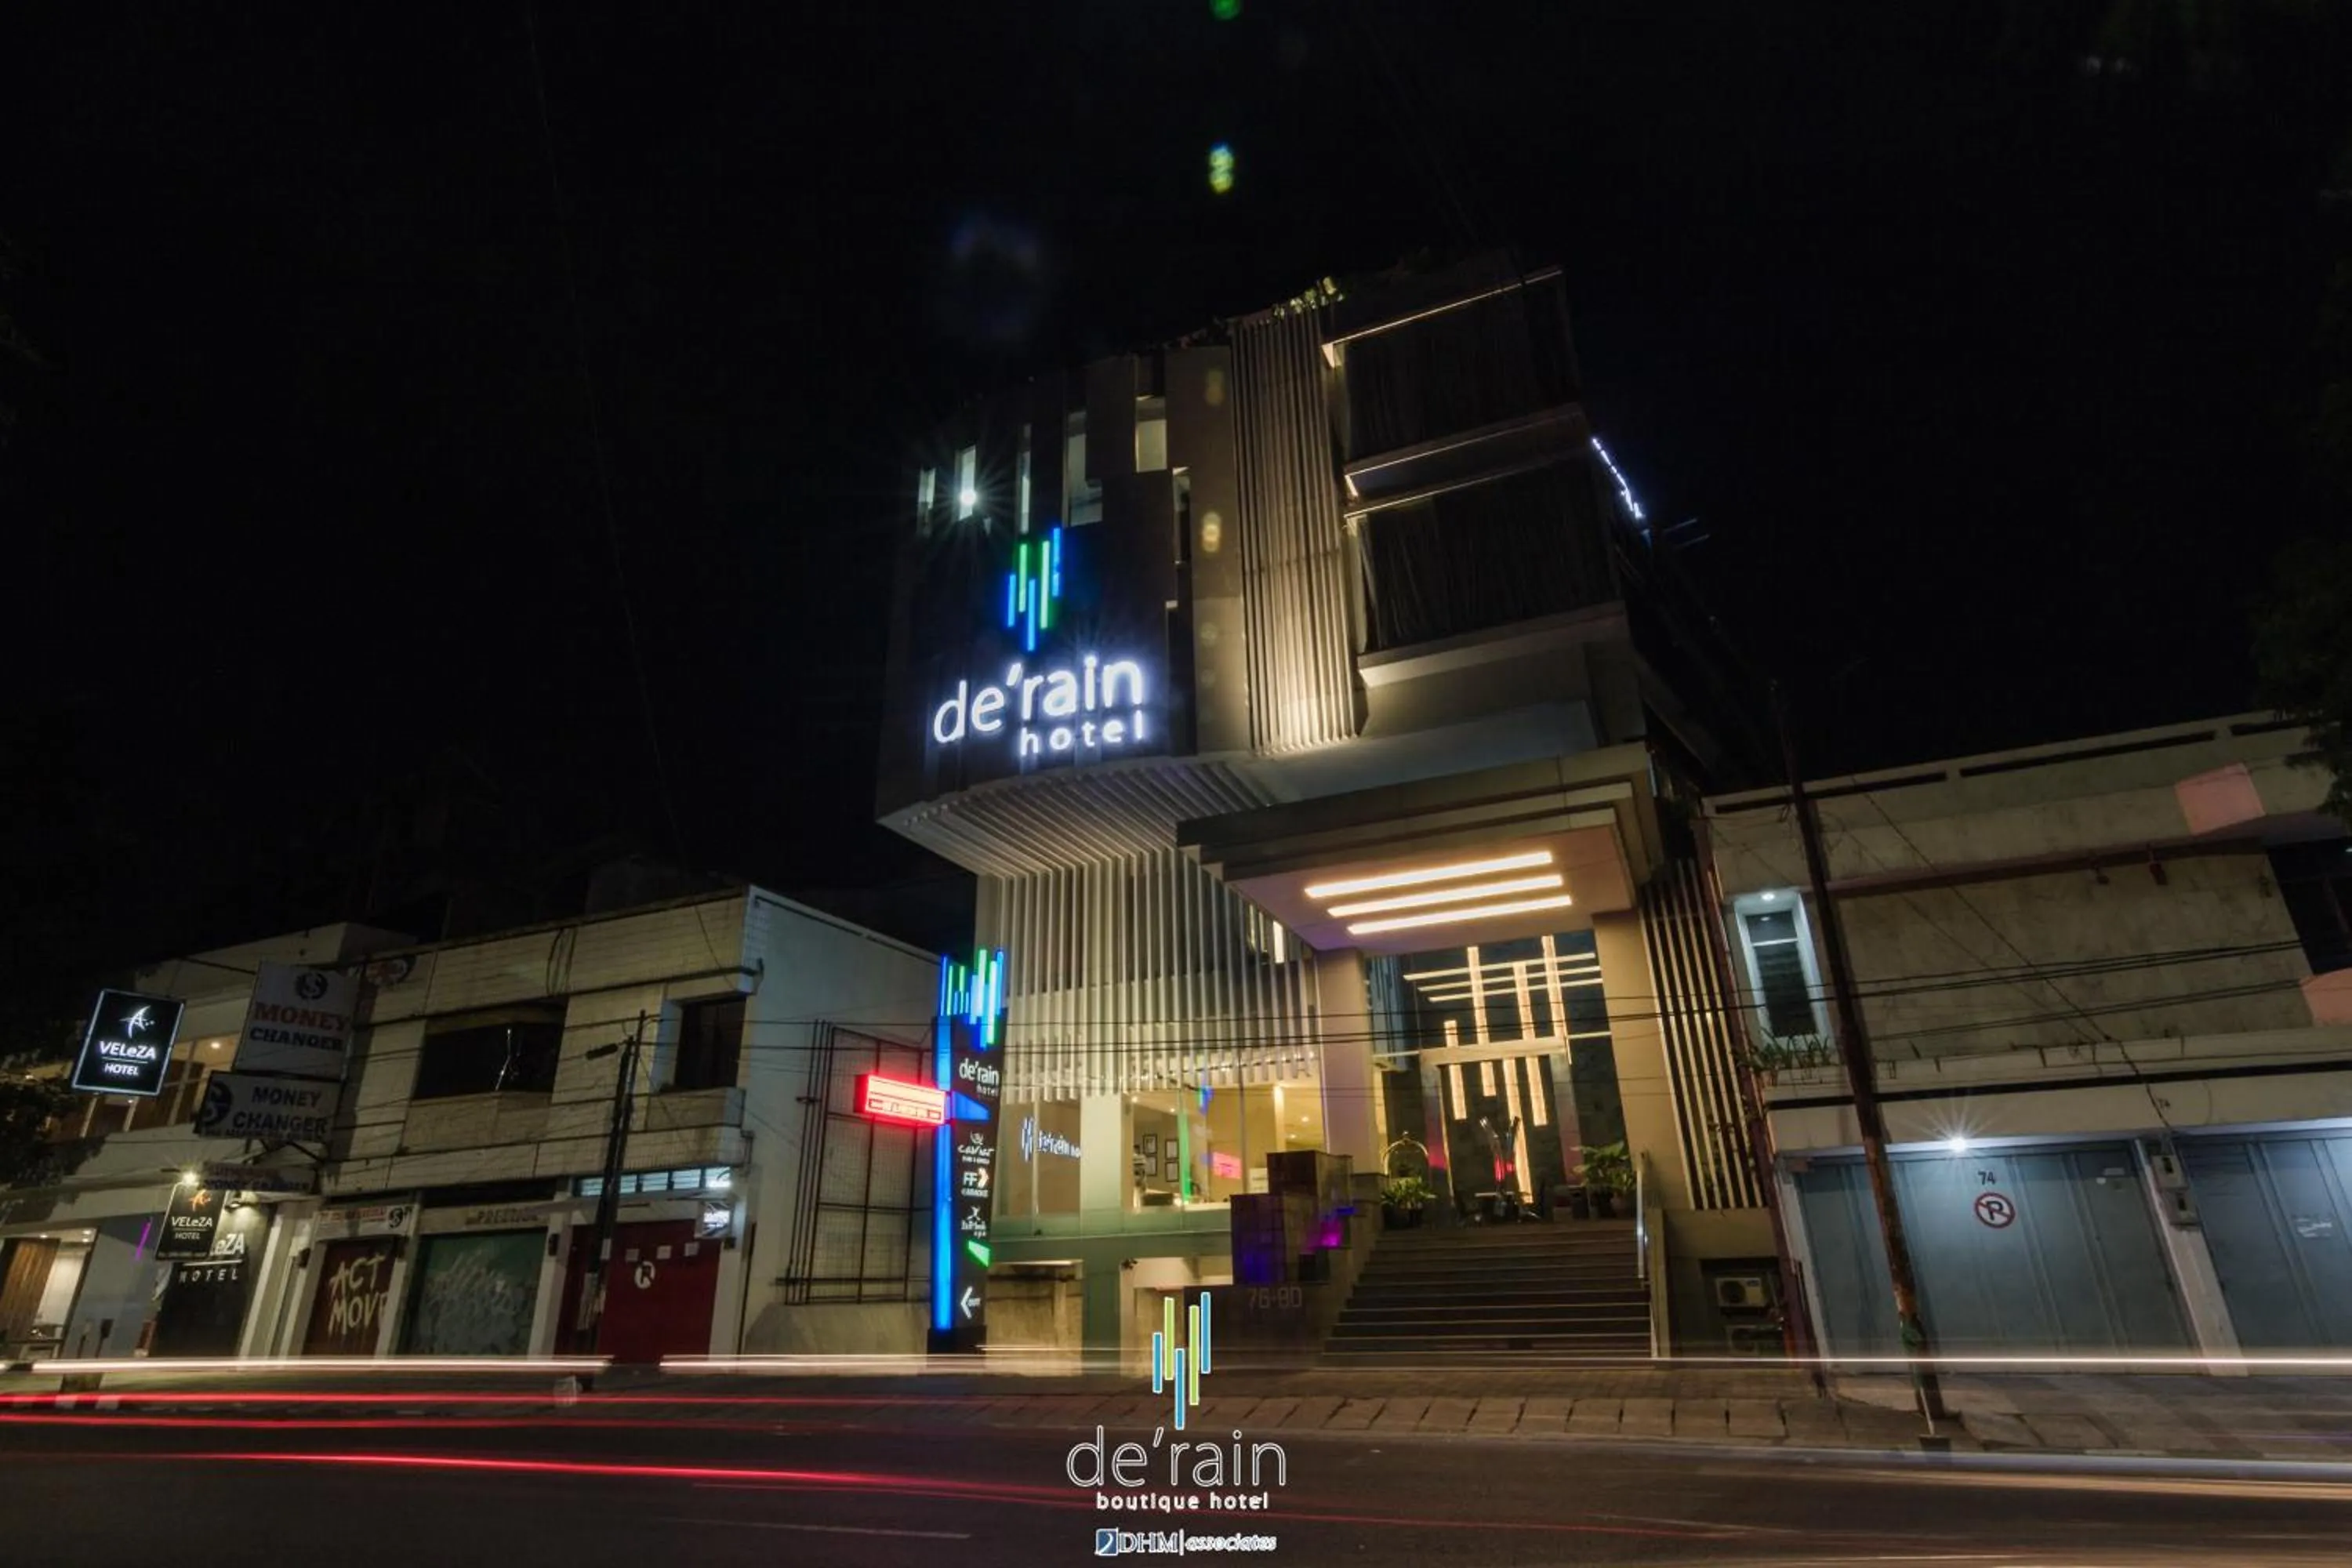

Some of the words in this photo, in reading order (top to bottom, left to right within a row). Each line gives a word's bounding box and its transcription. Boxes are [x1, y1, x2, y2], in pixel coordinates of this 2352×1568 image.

[933, 655, 1144, 743] de'rain
[1018, 710, 1144, 756] hotel
[253, 1002, 350, 1032] MONEY
[249, 1027, 343, 1051] CHANGER
[103, 1063, 139, 1076] HOTEL
[959, 1058, 1000, 1085] de'rain
[252, 1087, 321, 1107] MONEY
[233, 1111, 328, 1134] CHANGER
[1977, 1171, 1995, 1185] 74
[175, 1232, 201, 1240] HOTEL
[209, 1232, 245, 1257] eZA
[179, 1268, 239, 1283] HOTEL
